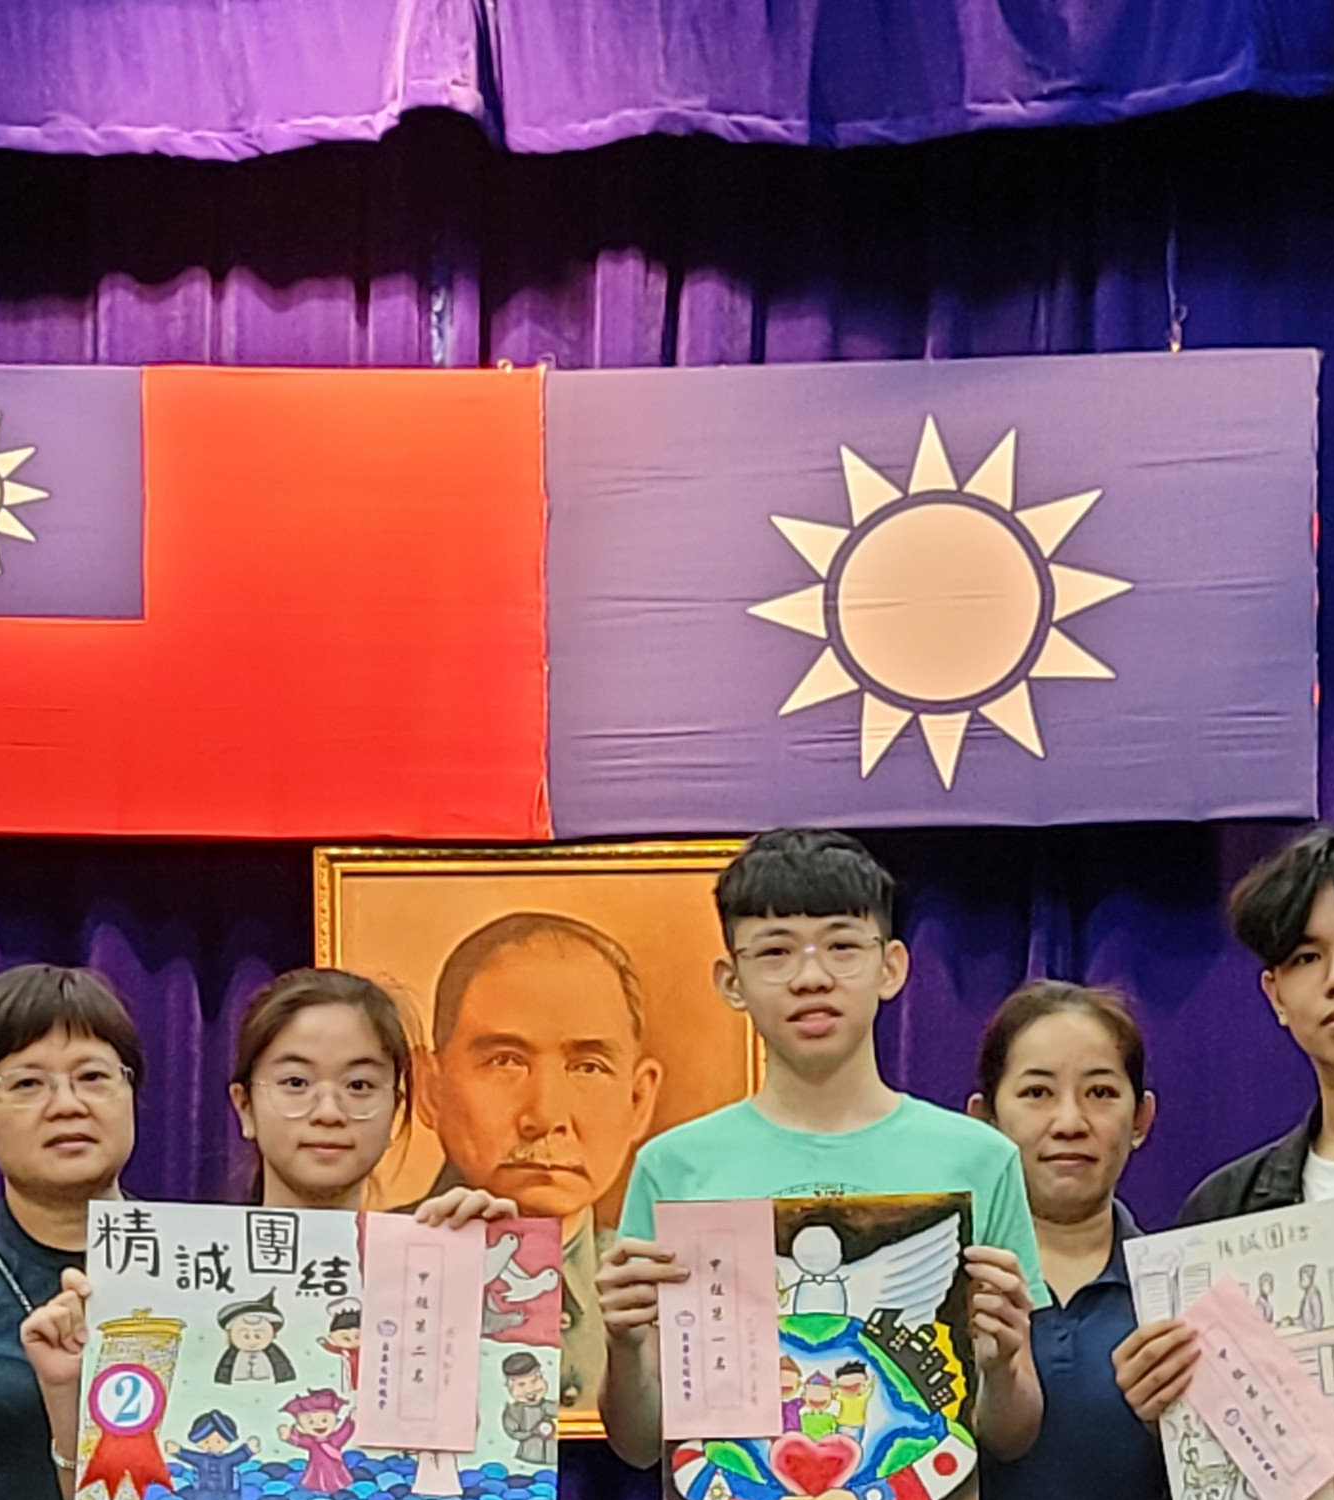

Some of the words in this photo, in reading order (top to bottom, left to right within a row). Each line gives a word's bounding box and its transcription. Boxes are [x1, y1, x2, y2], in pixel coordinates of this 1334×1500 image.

[92, 1208, 352, 1297] 精誠團結
[114, 1375, 141, 1422] 2
